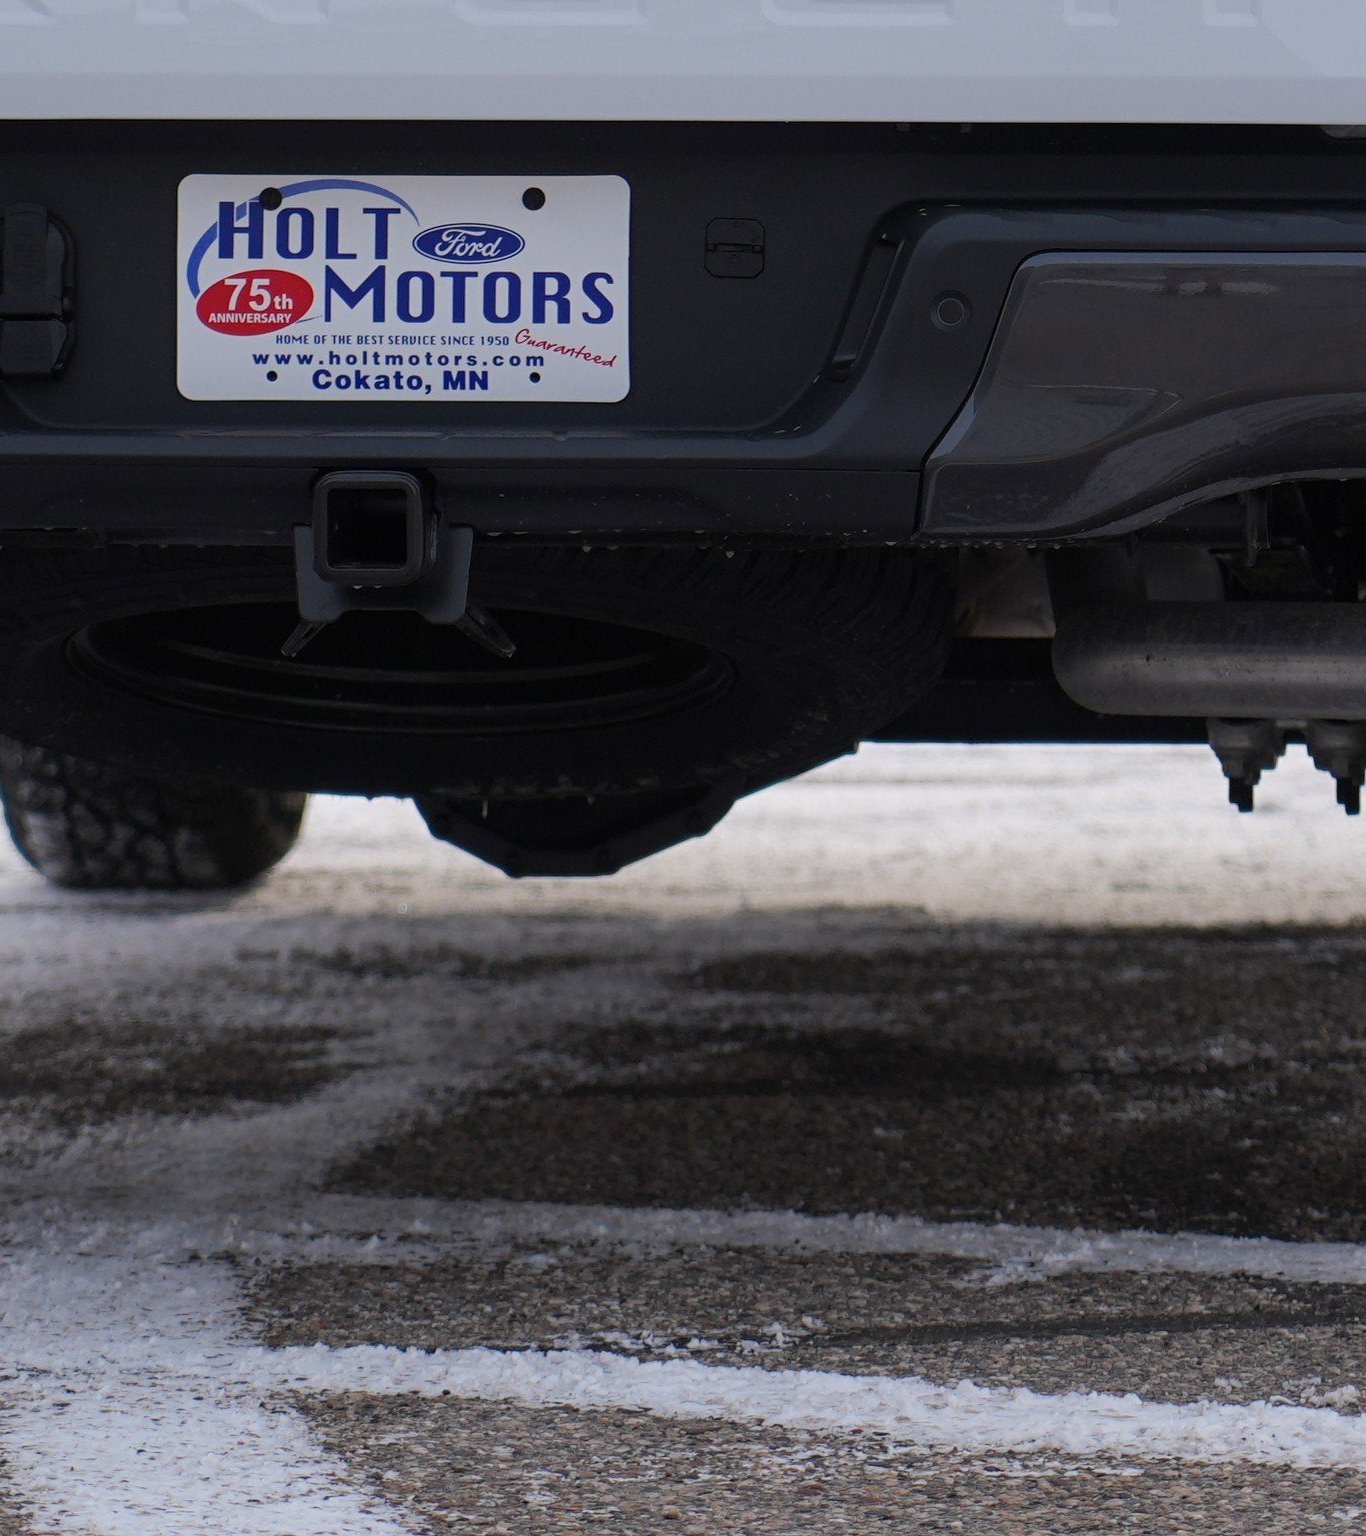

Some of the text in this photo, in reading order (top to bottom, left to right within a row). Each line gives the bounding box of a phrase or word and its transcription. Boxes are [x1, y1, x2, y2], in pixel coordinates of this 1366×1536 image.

[218, 201, 401, 260] HOLT
[434, 228, 504, 257] Ford
[224, 278, 294, 312] 75th
[324, 264, 615, 325] MOTORS
[208, 312, 292, 324] ANNIVERSARY
[275, 334, 510, 346] HOME OF THE BEST SERVICE SINCE 1950
[515, 328, 618, 368] Guaranteed
[252, 350, 545, 367] www.holtmotors.com
[312, 368, 489, 395] Cokato, MN
